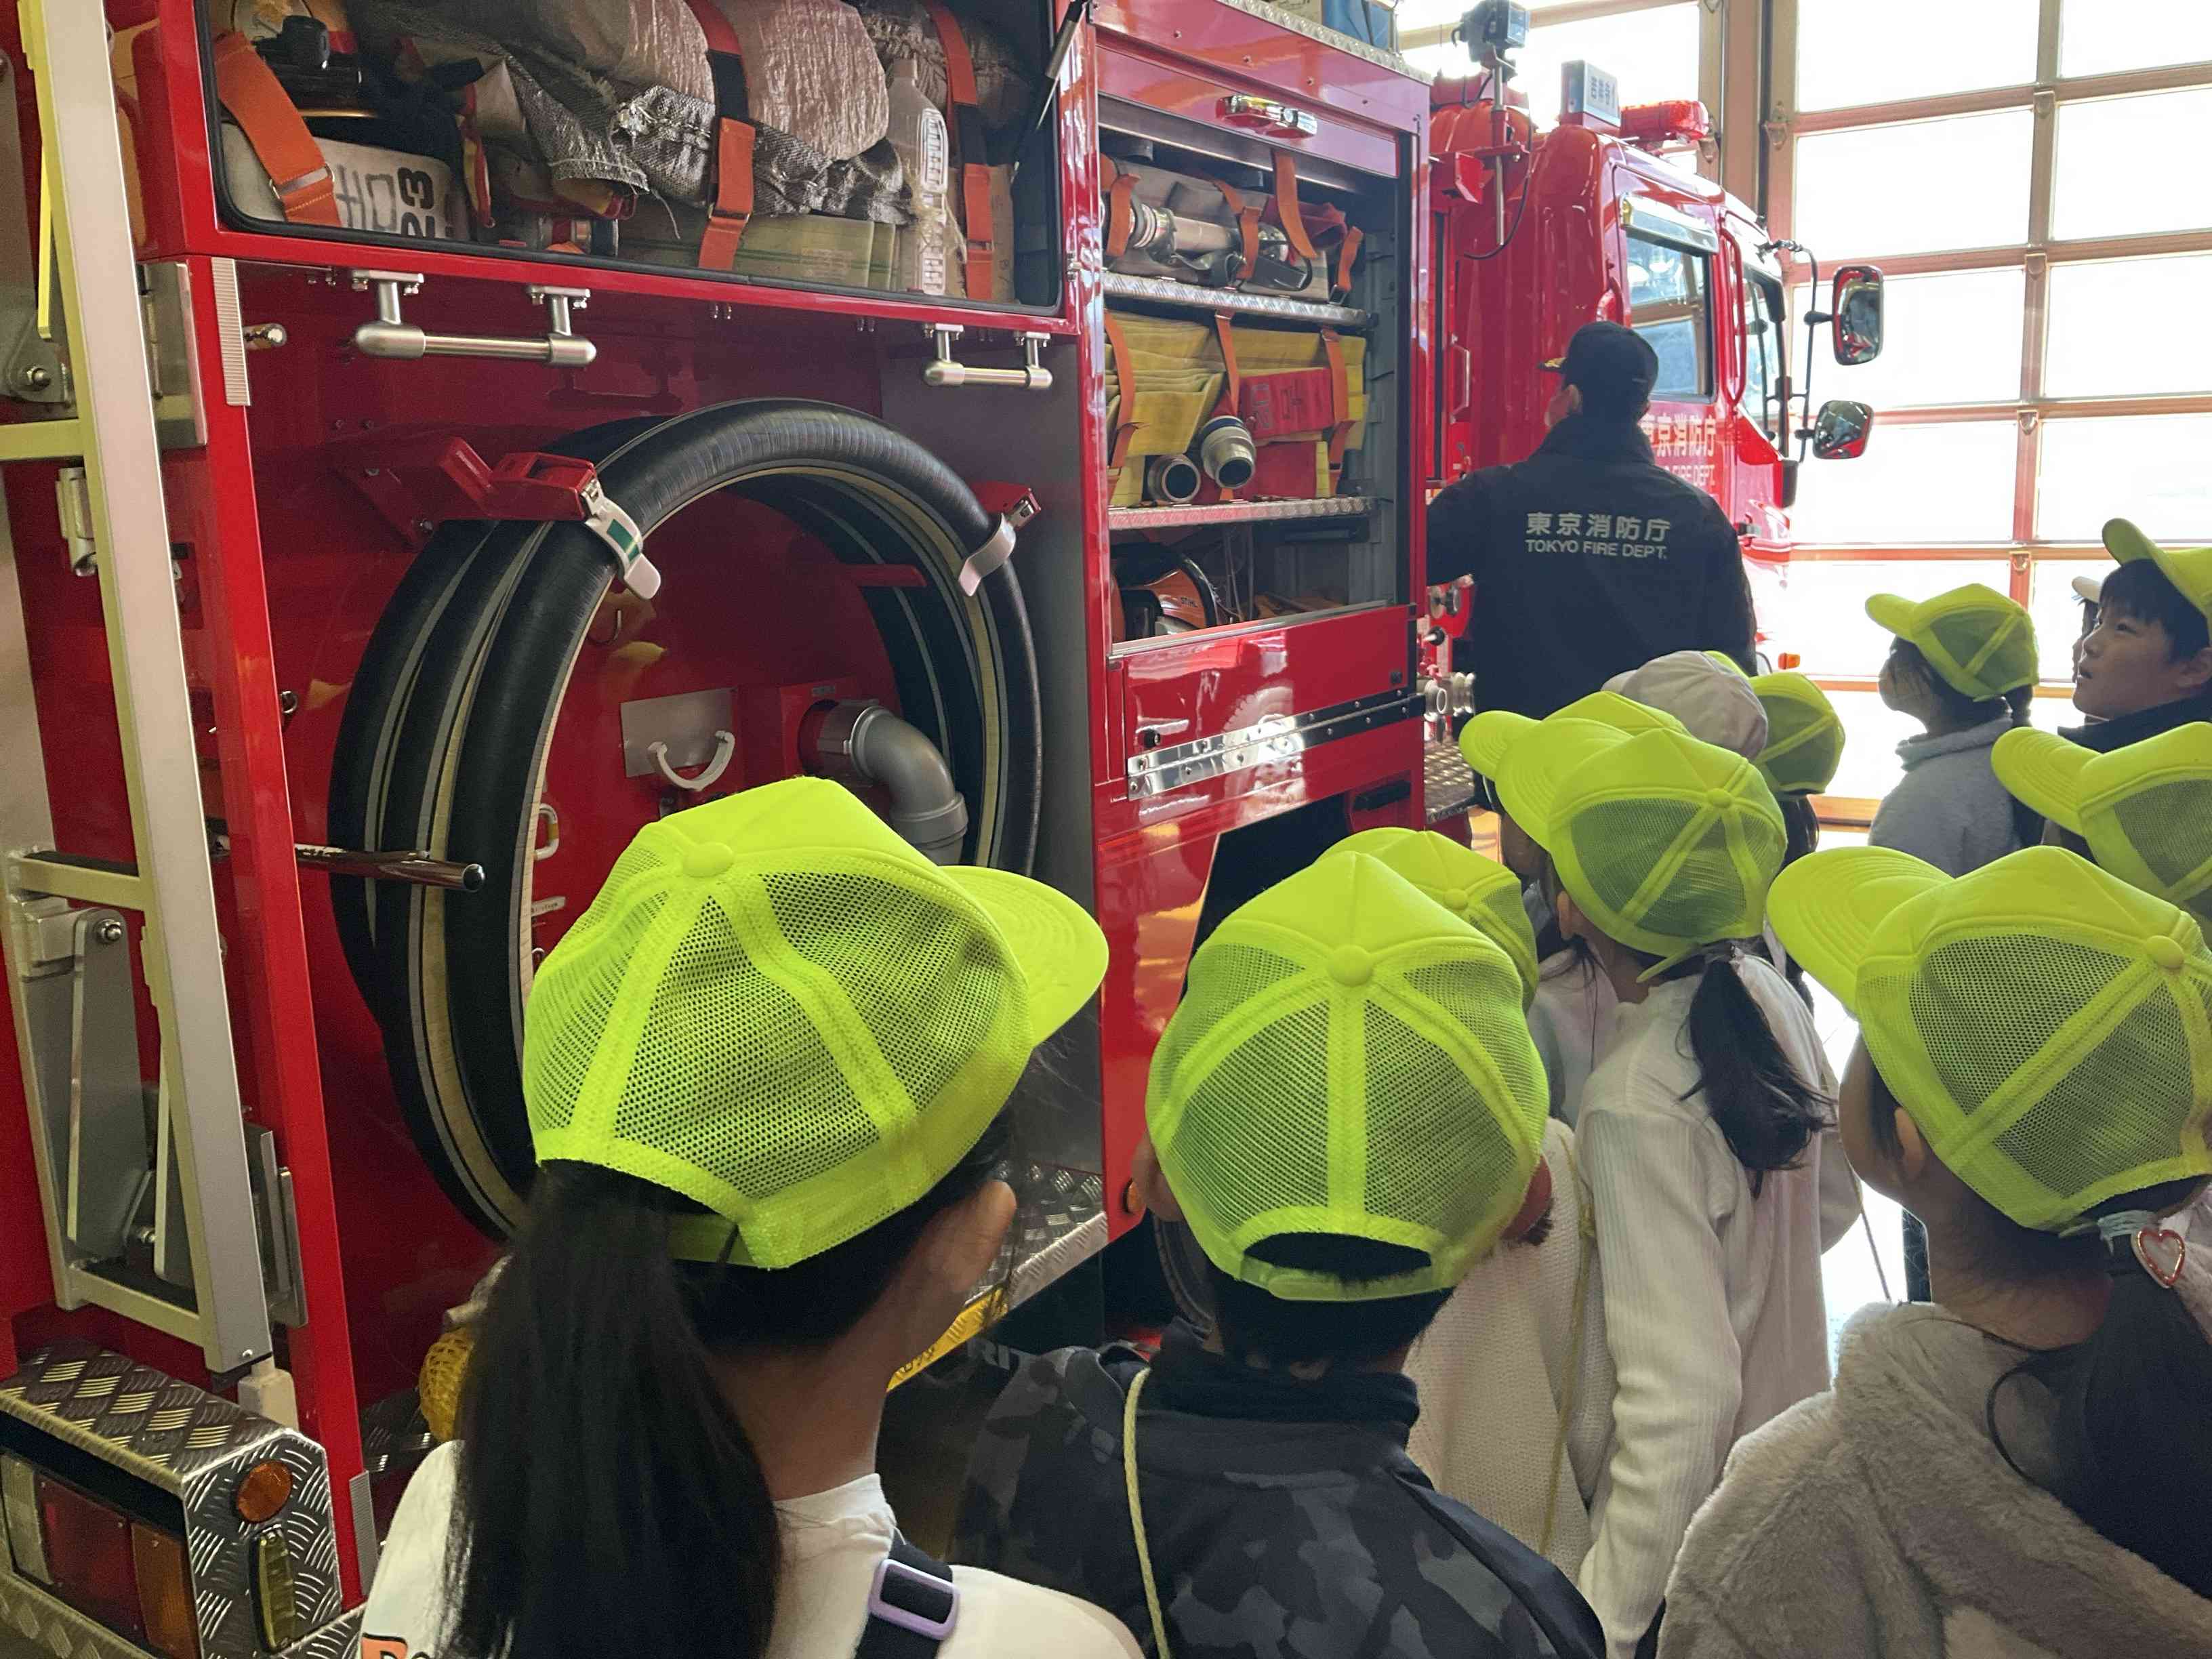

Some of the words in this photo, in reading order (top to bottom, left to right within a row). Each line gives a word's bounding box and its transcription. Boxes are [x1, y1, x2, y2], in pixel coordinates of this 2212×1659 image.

[1525, 512, 1671, 541] 東京消防庁
[1525, 539, 1578, 554] TOKYO
[1583, 541, 1617, 556] FIRE
[1622, 544, 1667, 559] DEPT.
